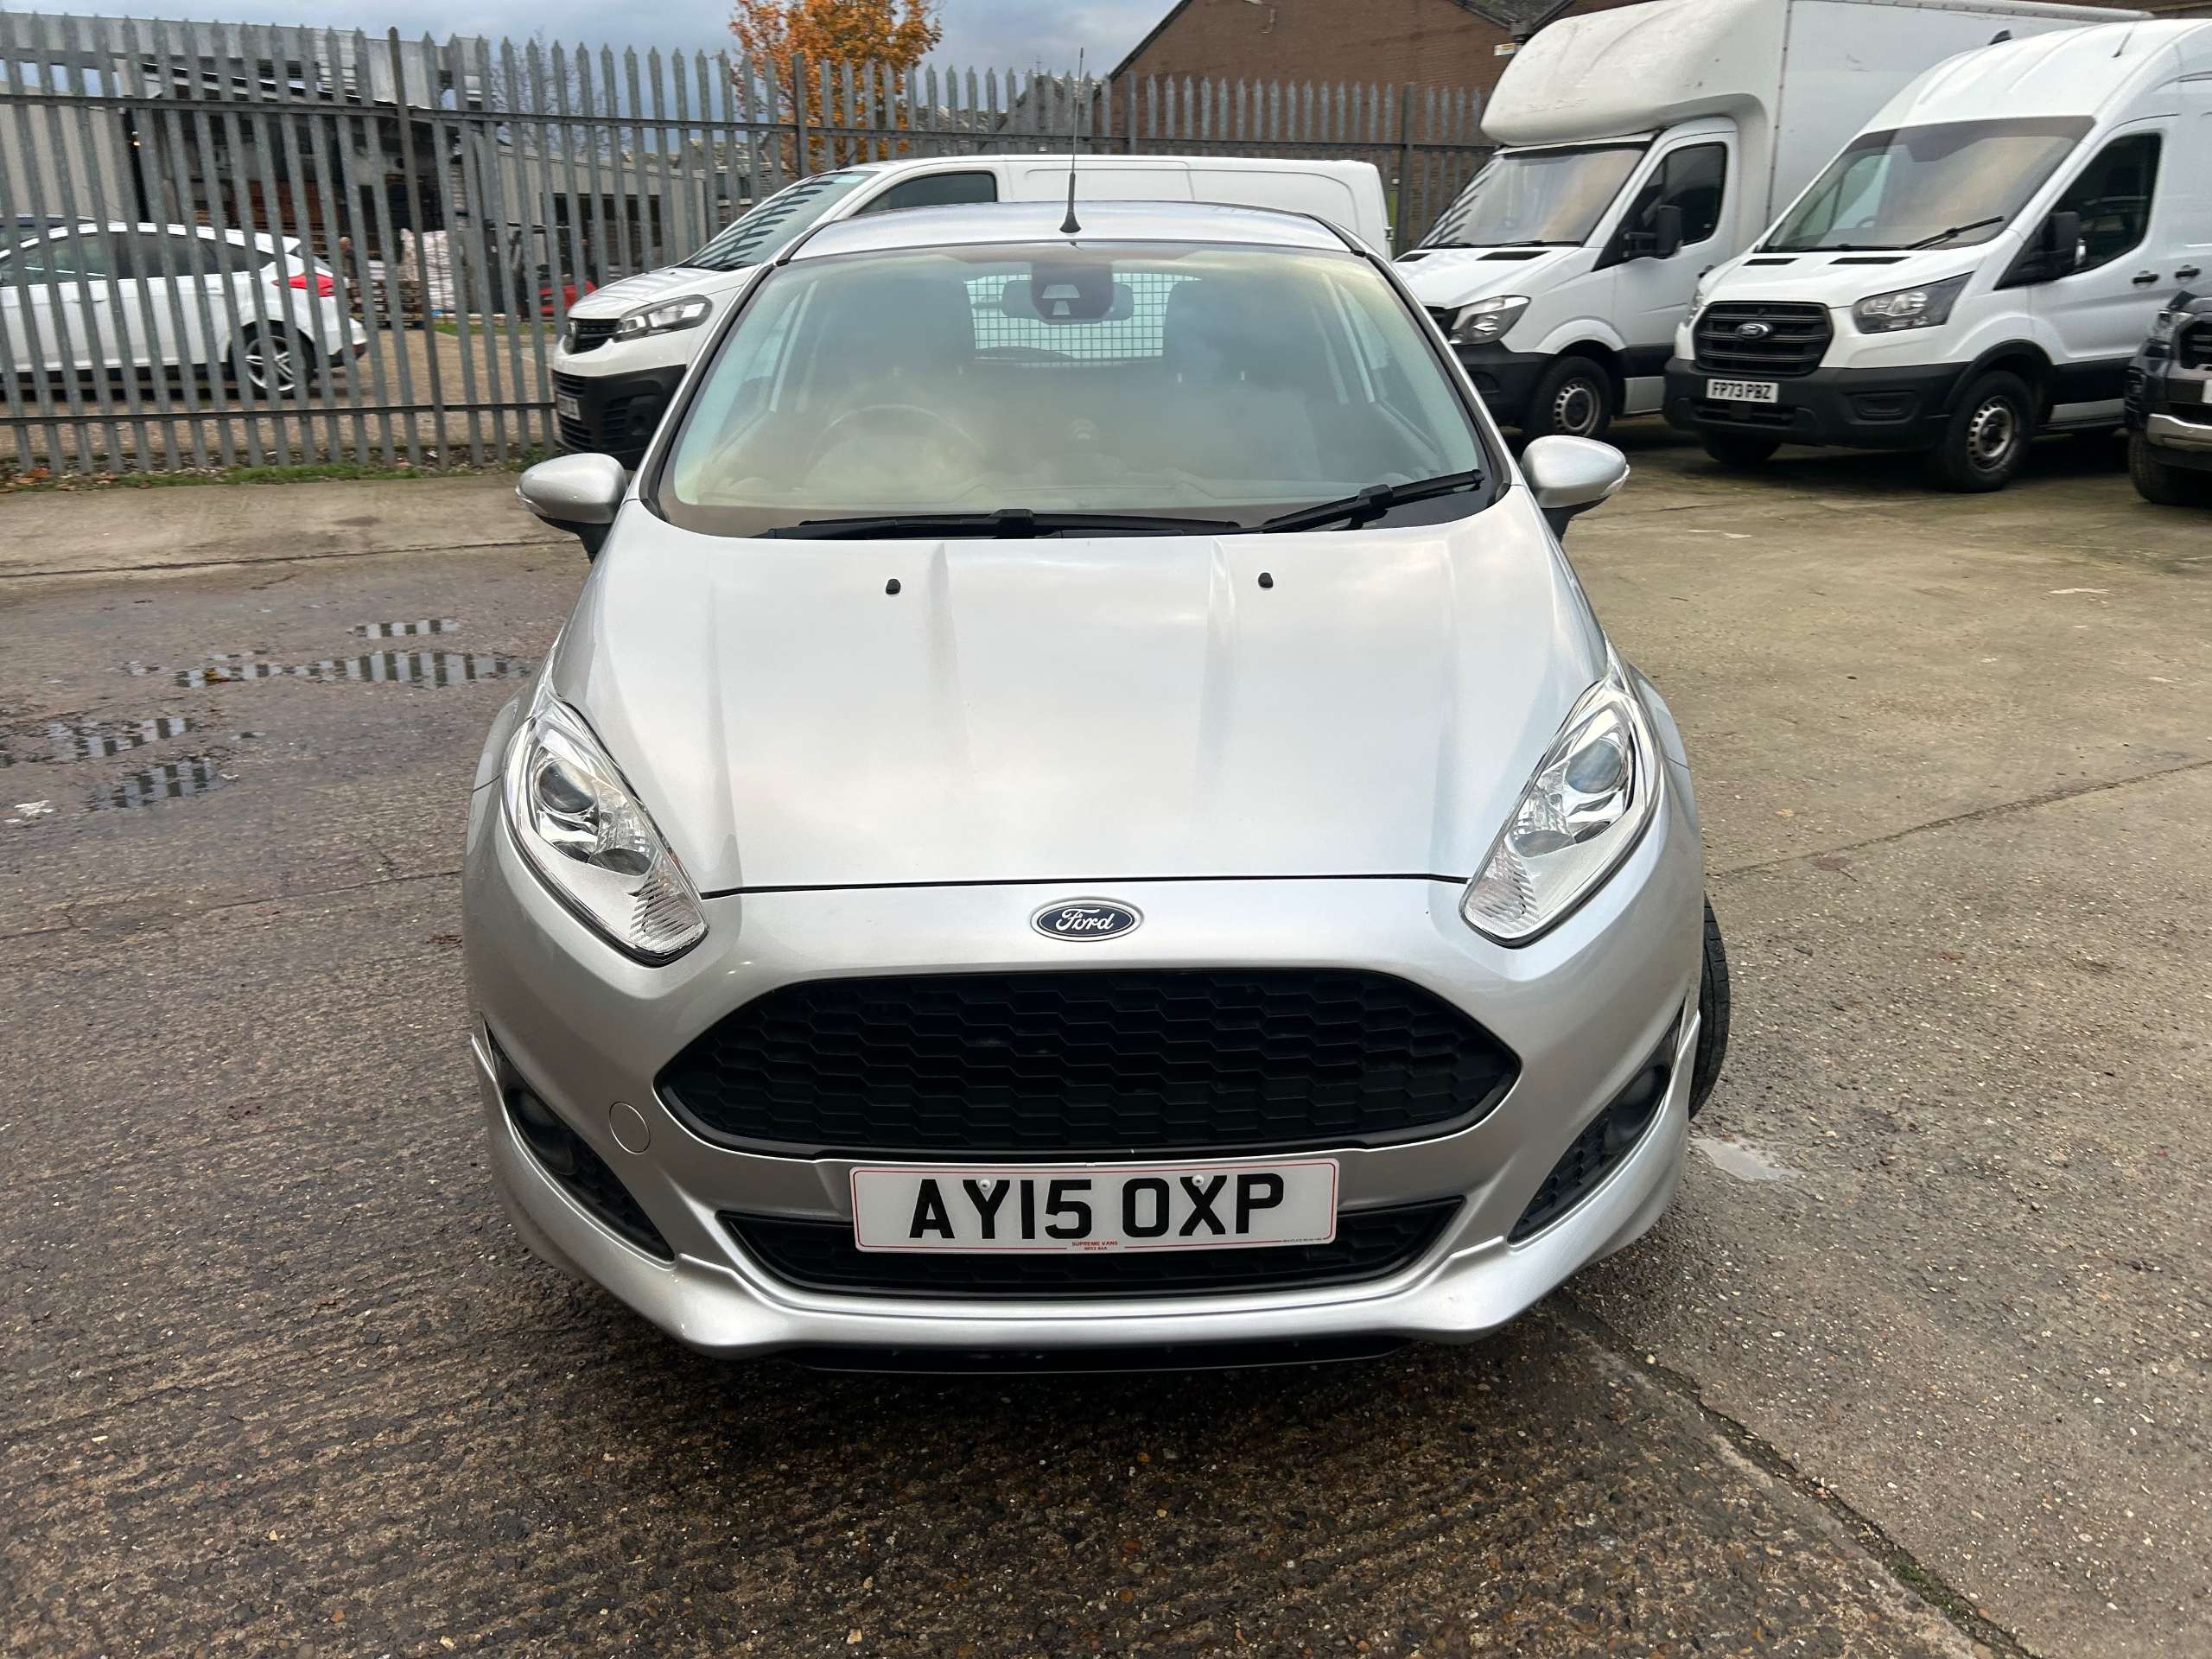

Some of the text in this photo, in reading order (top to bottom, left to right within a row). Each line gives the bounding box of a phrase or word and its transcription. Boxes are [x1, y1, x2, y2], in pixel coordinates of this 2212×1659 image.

[1055, 908, 1115, 931] Ford
[909, 1173, 1284, 1240] AY15 OXP
